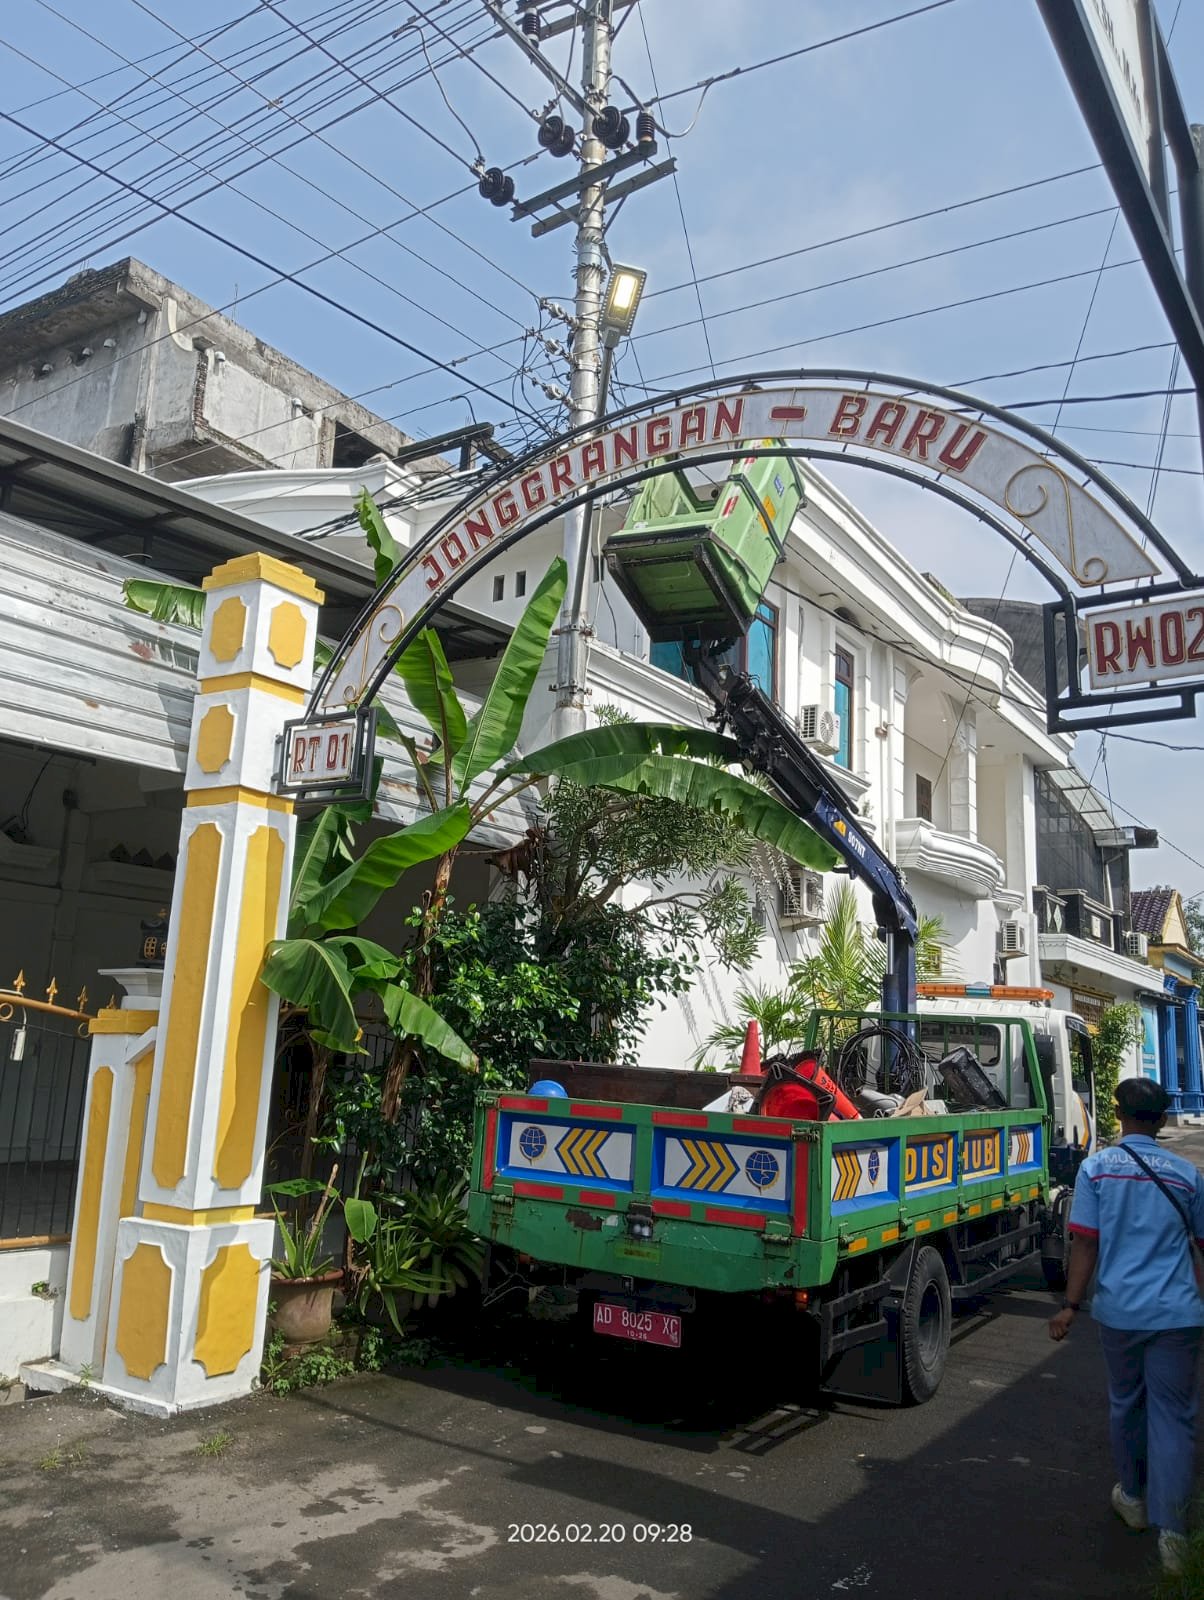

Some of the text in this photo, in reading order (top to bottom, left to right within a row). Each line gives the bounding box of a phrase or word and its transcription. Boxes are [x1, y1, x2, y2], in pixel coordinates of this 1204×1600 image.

[421, 397, 745, 591] JONGGRANGAN
[828, 394, 988, 473] BARU
[1094, 607, 1204, 676] RW02
[292, 732, 350, 773] RT 01
[597, 1306, 612, 1324] AD
[621, 1310, 652, 1332] 8025
